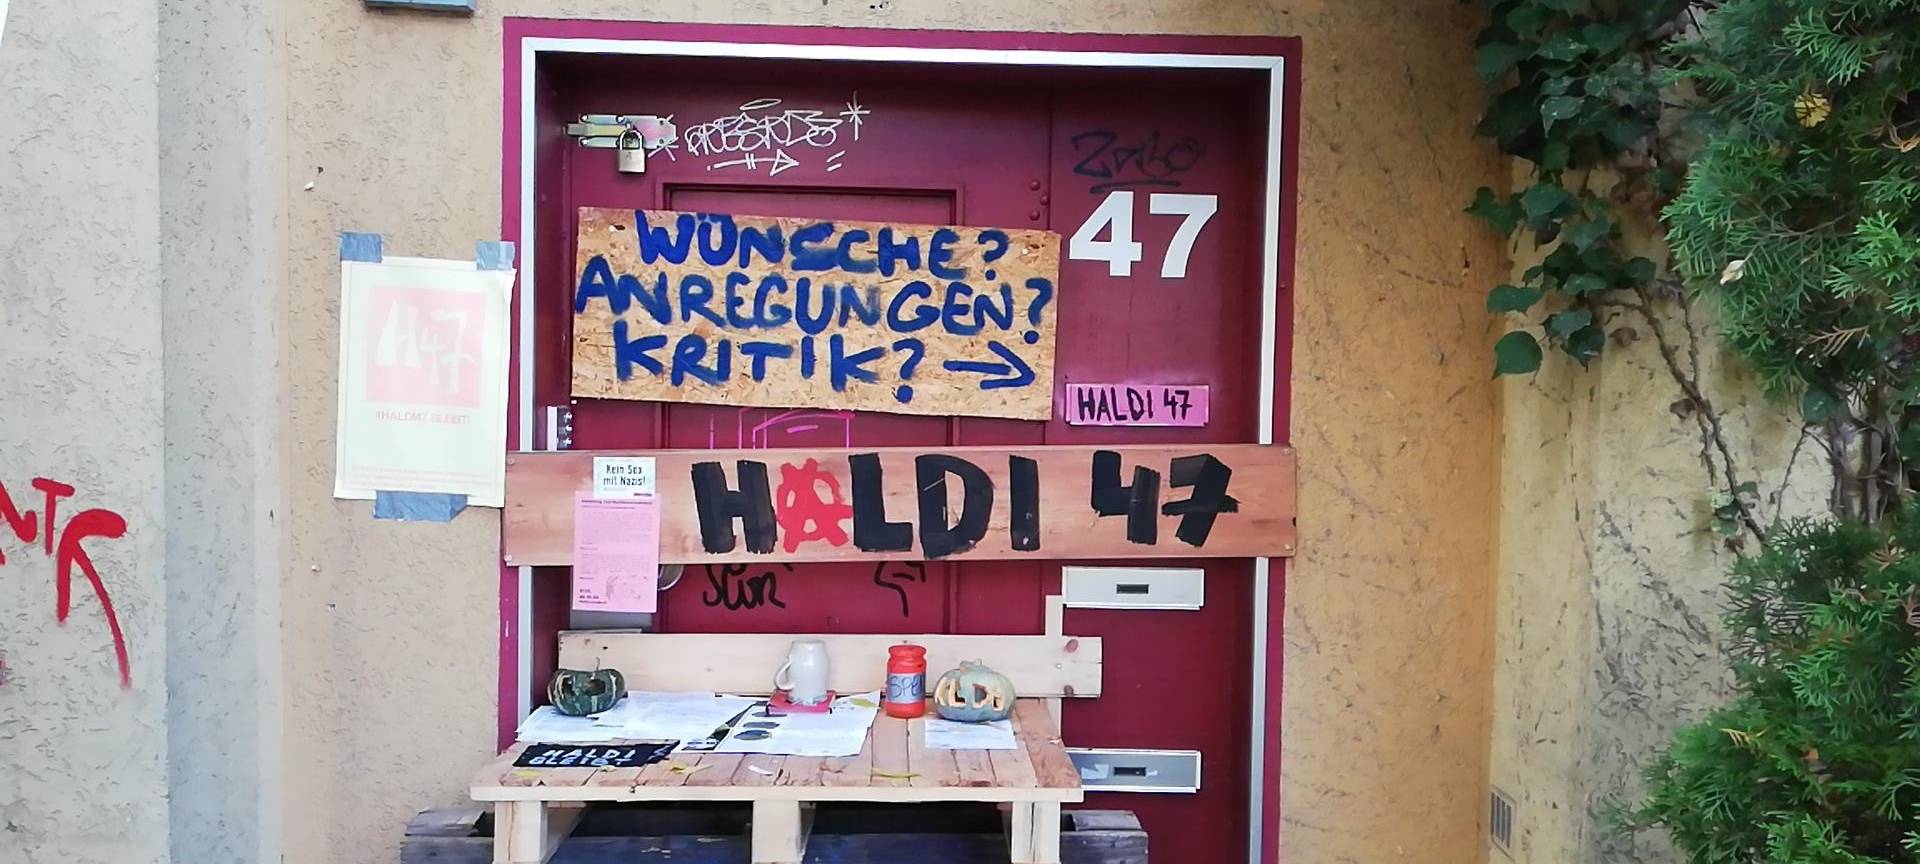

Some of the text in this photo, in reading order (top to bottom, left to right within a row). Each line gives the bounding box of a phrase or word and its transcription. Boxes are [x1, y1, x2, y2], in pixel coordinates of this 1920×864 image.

[635, 208, 1009, 281] WÜNSCHE?
[1069, 191, 1217, 278] 47
[574, 255, 1054, 345] ANREGUNGEN?
[613, 320, 925, 404] KRITIK?
[1077, 387, 1193, 421] HALDI 47
[603, 475, 647, 486] mit Nazis!
[606, 464, 625, 475] Kein
[691, 450, 1241, 558] HALDI 47
